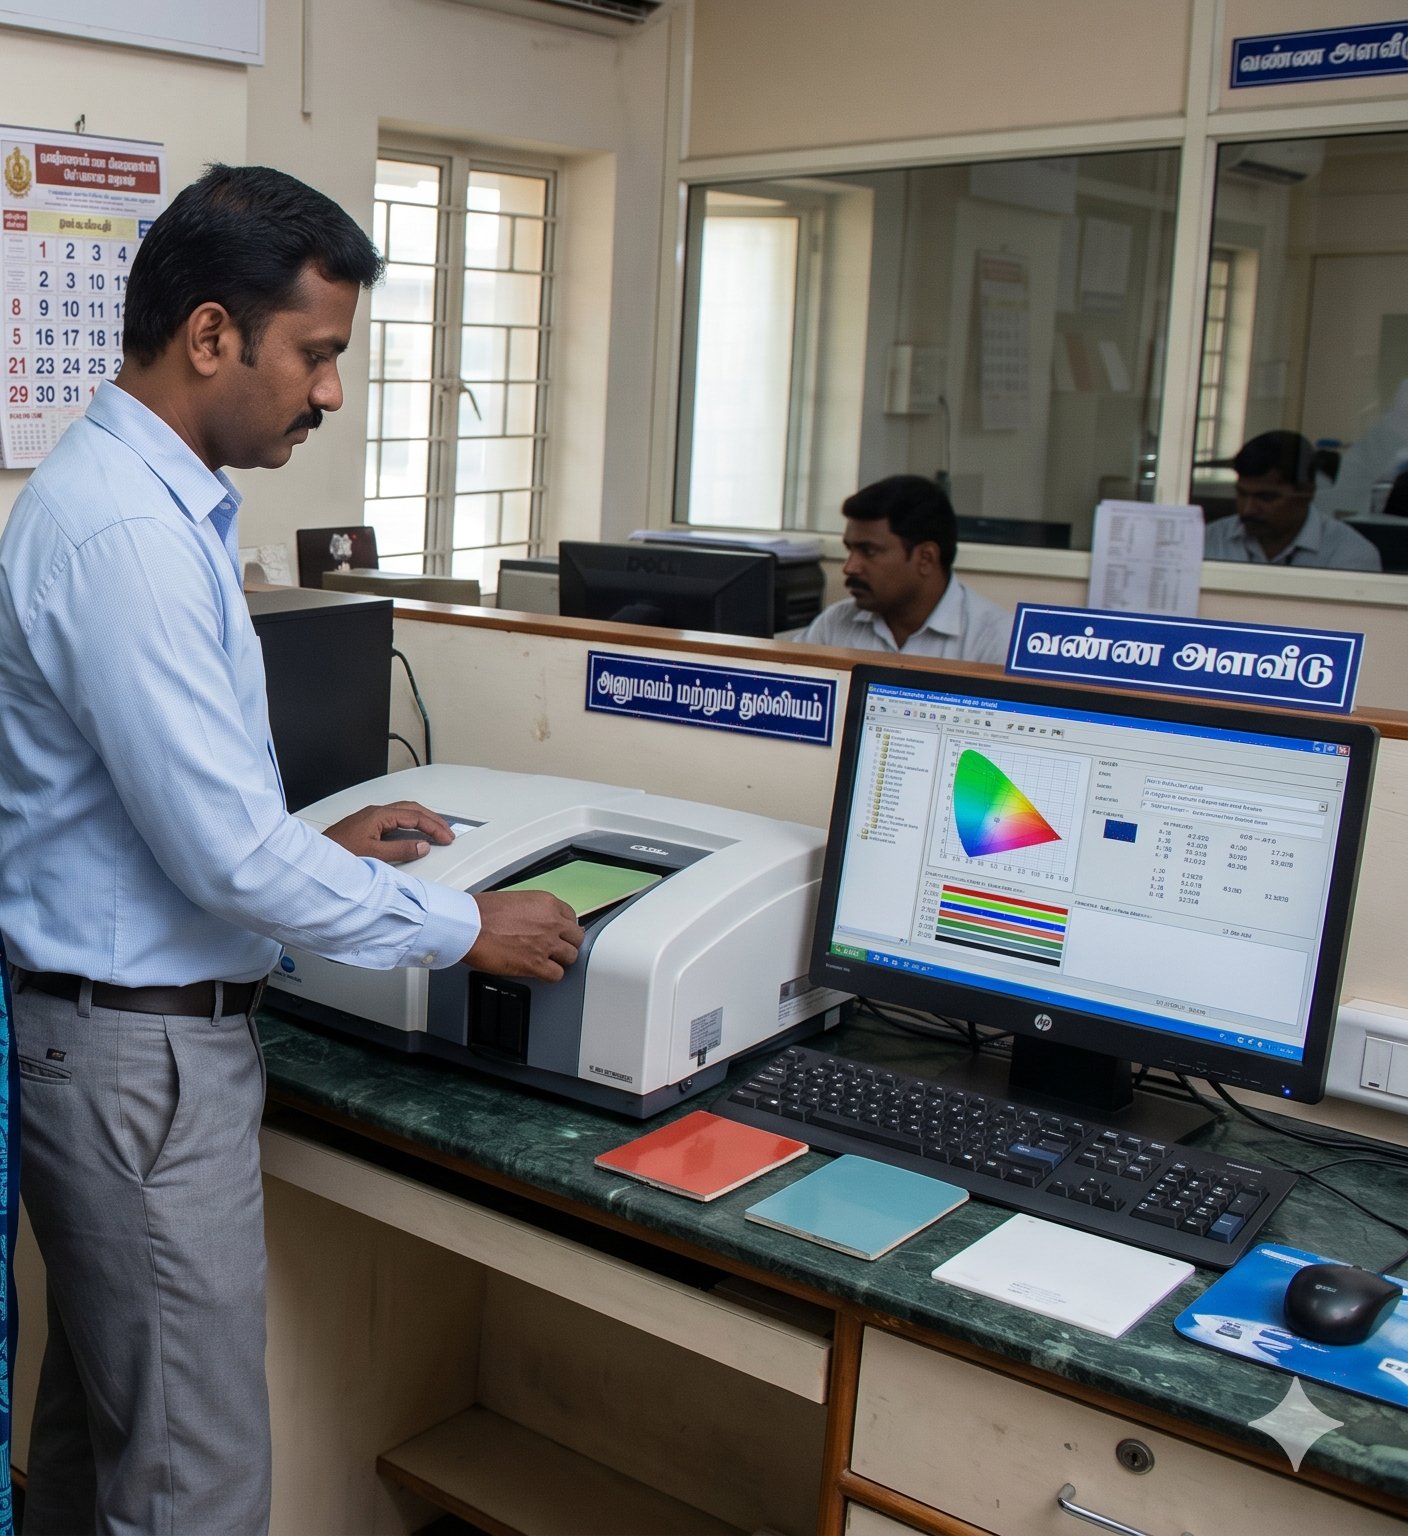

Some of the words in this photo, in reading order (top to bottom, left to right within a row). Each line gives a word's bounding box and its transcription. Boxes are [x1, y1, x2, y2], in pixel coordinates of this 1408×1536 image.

[1240, 44, 1326, 72] வண்ண
[1328, 32, 1408, 64] அளவீ
[39, 241, 46, 258] 1
[66, 242, 75, 260] 2
[92, 244, 102, 261] 3
[117, 246, 127, 263] 4
[39, 270, 49, 288] 2
[66, 272, 76, 289] 3
[88, 273, 105, 290] 10
[11, 298, 21, 316] 8
[39, 299, 49, 317] 9
[62, 300, 80, 317] 10
[88, 301, 104, 318] 11
[114, 302, 126, 319] 1
[12, 328, 21, 345] 5
[36, 328, 54, 346] 16
[62, 329, 80, 346] 17
[88, 329, 106, 347] 18
[113, 330, 124, 347] 1
[8, 357, 26, 374] 21
[36, 357, 55, 374] 23
[62, 357, 81, 374] 24
[88, 358, 106, 375] 25
[113, 358, 122, 375] 2
[9, 385, 28, 403] 29
[36, 385, 55, 403] 30
[63, 385, 80, 403] 31
[1027, 626, 1165, 666] வண்ண
[1173, 643, 1334, 688] அளவீடு
[597, 671, 673, 704] அனுபவம்
[676, 678, 736, 716] மற்றும்
[738, 687, 822, 721] துல்லியம்
